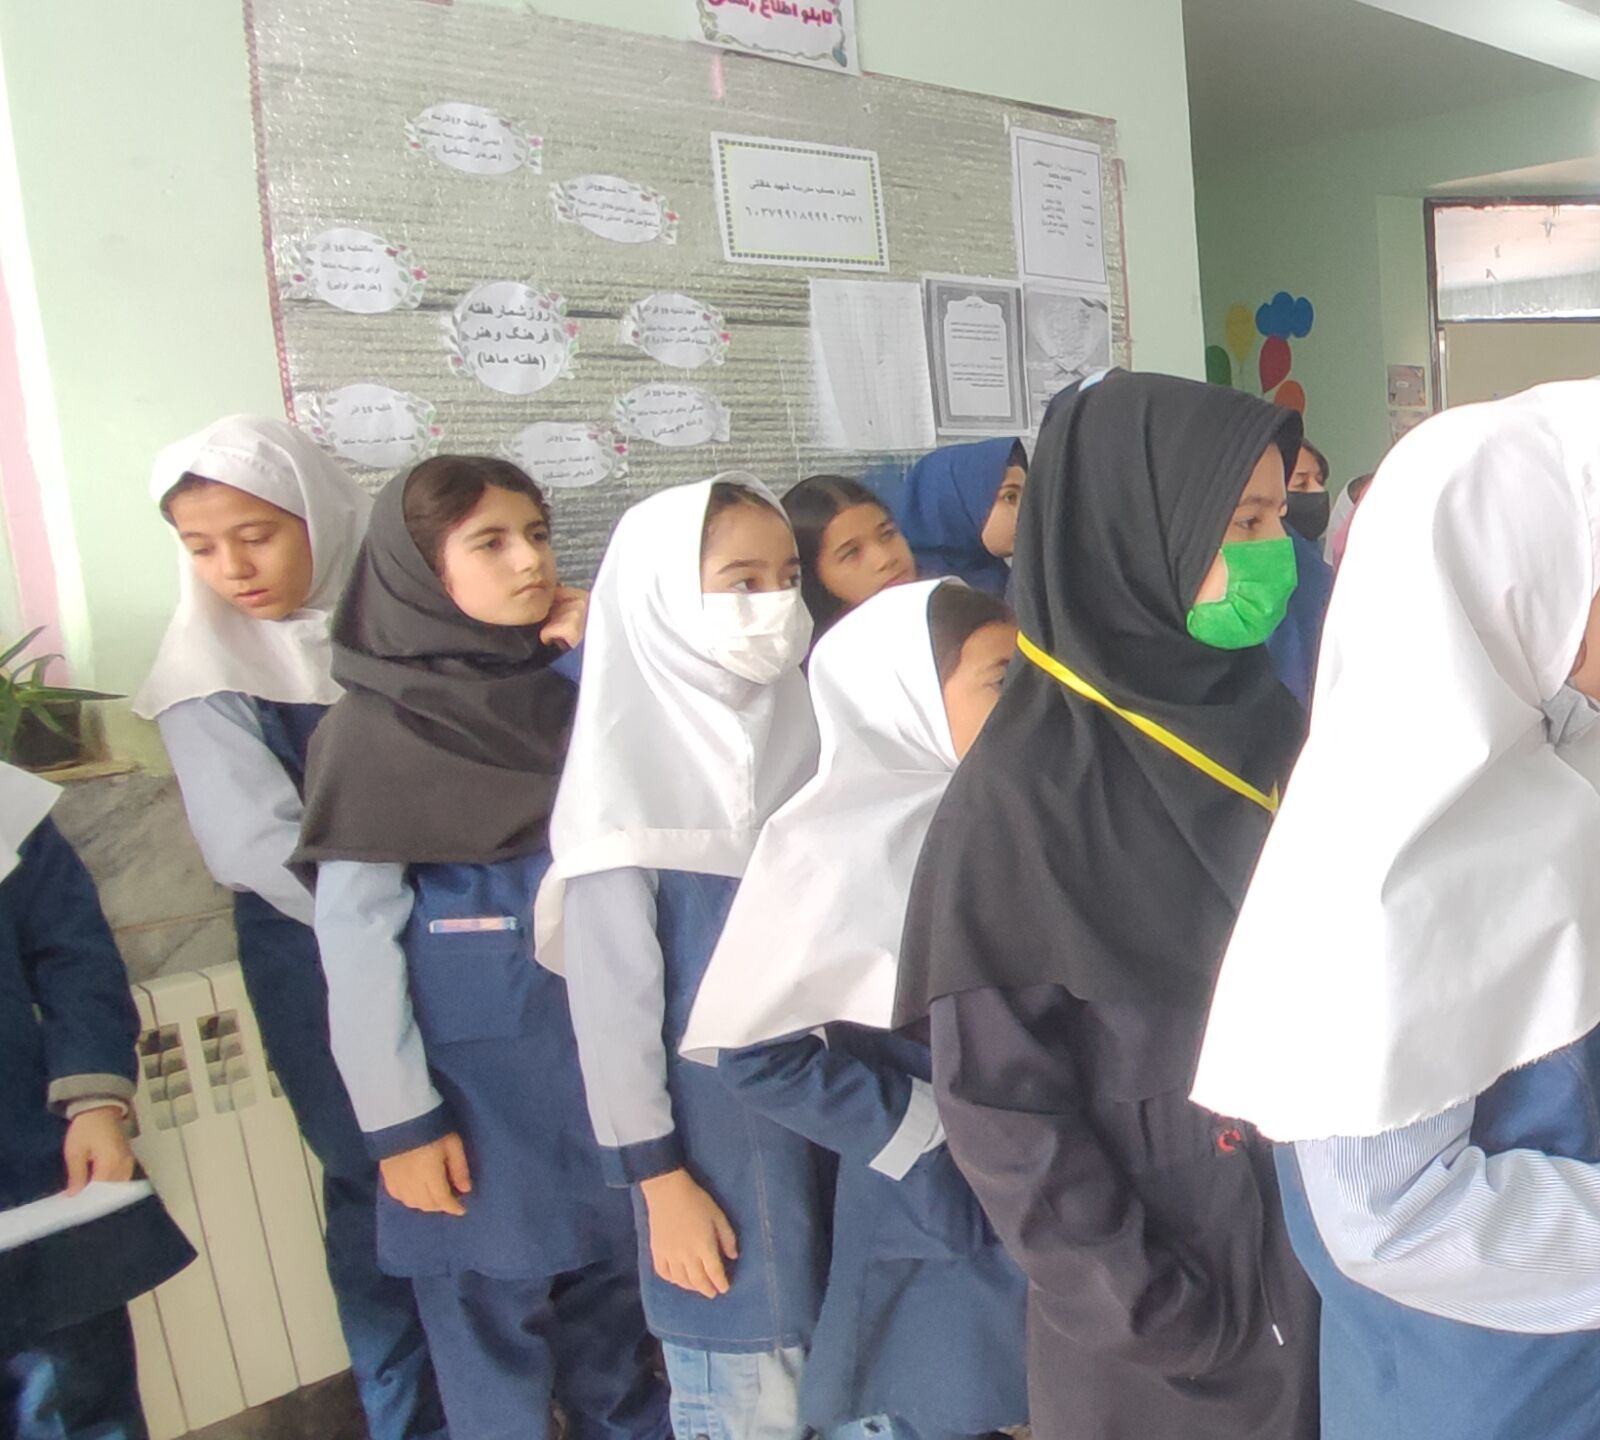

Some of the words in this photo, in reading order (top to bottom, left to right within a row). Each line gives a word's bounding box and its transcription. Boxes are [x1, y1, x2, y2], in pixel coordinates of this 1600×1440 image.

[467, 301, 493, 315] هفته
[471, 326, 492, 341] هنر
[505, 326, 550, 344] فرهنگ
[513, 353, 546, 371] (هفته
